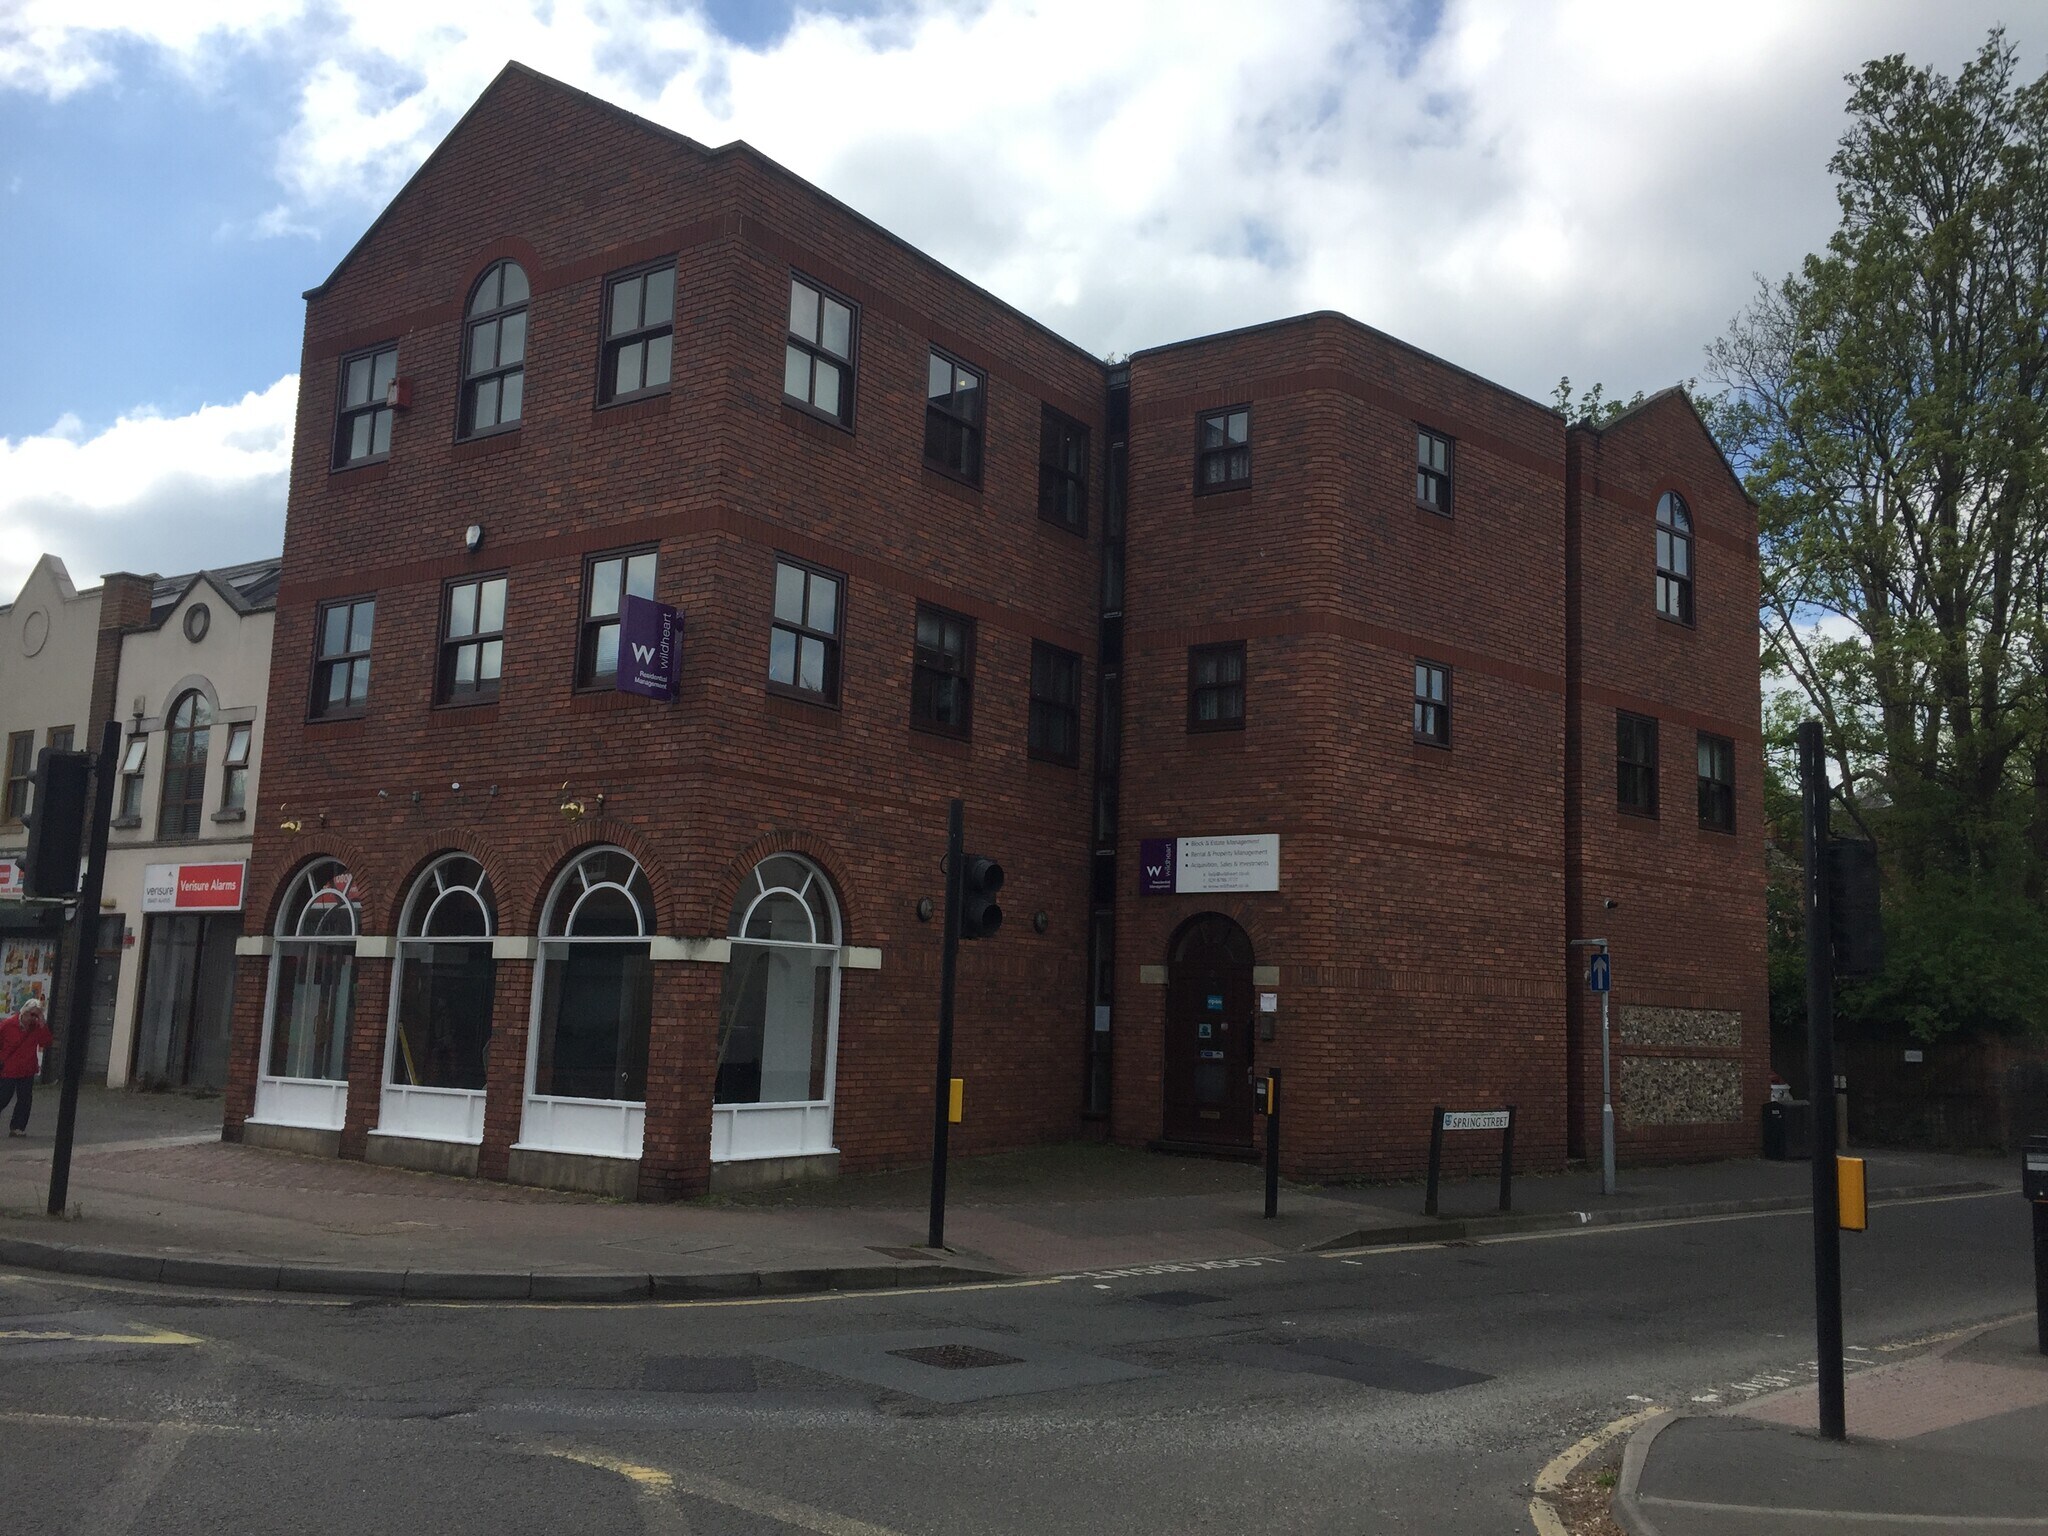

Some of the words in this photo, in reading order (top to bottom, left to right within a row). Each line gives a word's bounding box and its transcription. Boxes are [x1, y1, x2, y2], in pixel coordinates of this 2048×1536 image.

[660, 613, 672, 669] wildheart
[639, 670, 668, 682] Residential
[634, 676, 667, 690] Management
[1226, 838, 1260, 846] Management
[1234, 849, 1268, 857] Management
[180, 880, 209, 891] Verisure
[210, 878, 237, 891] Alarms
[146, 886, 174, 896] verisure
[1453, 1117, 1481, 1128] SPRING
[1482, 1116, 1508, 1127] STREET
[1191, 1256, 1286, 1271] LOOK
